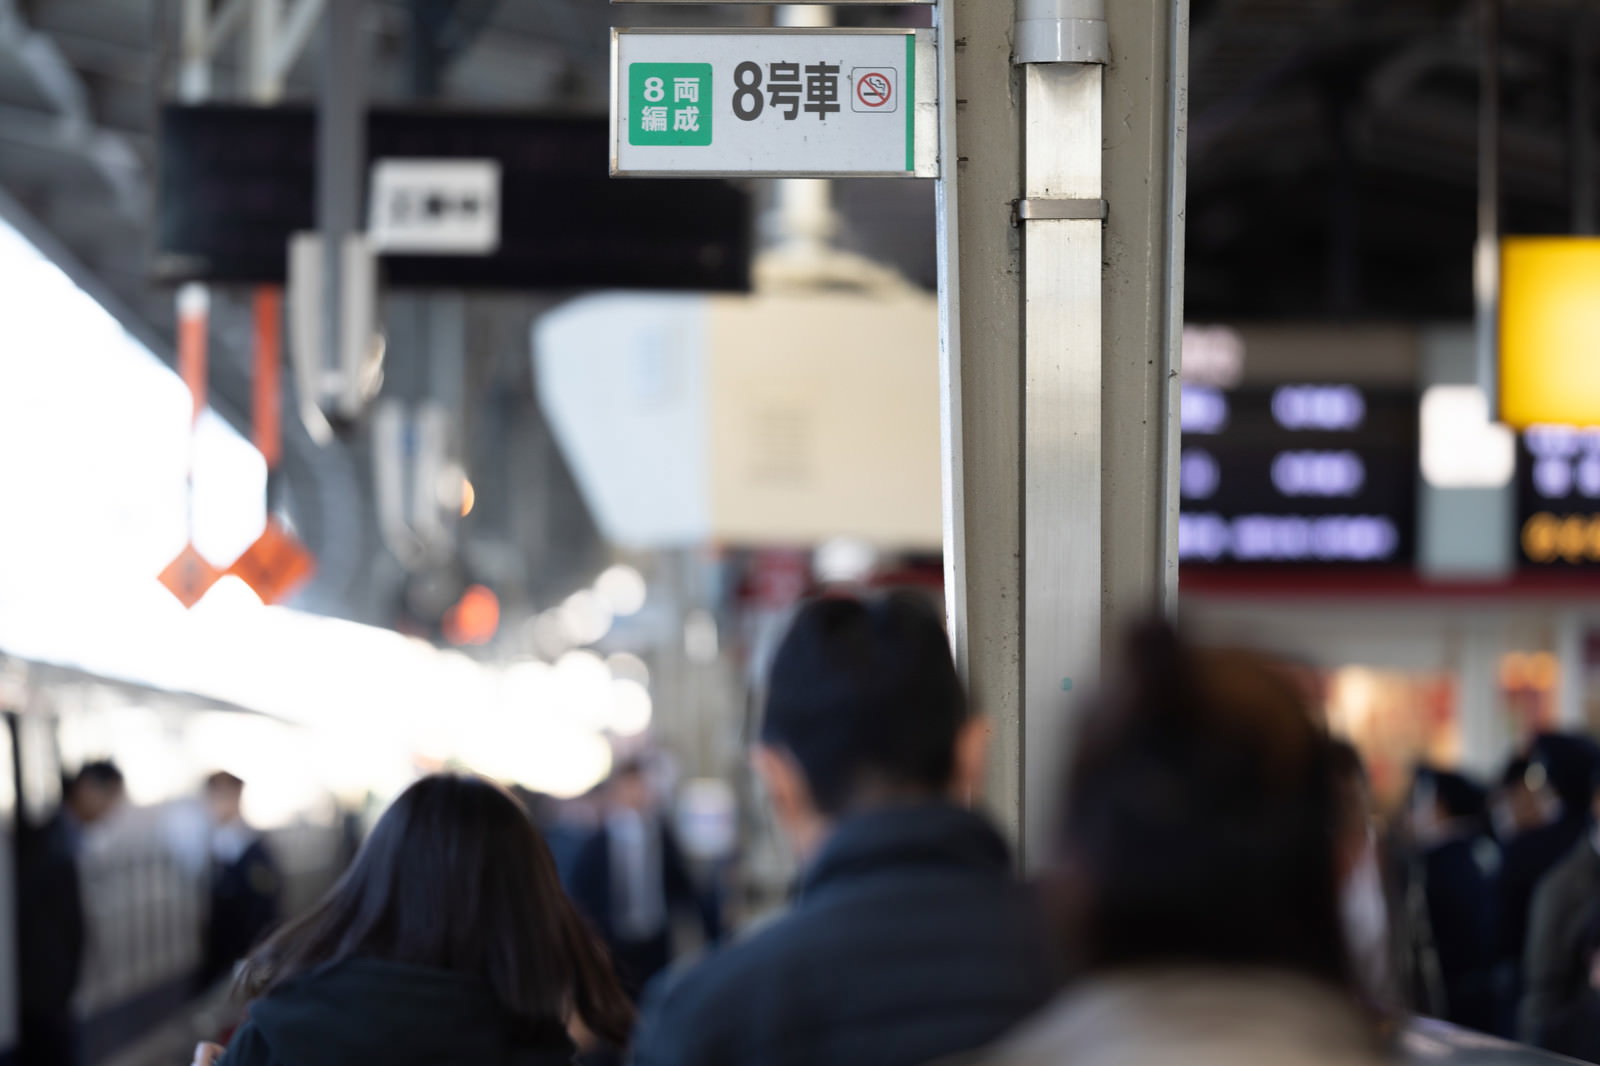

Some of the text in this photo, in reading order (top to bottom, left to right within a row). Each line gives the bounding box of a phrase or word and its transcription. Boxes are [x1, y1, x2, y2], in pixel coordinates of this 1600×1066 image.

[643, 77, 700, 103] 8両
[731, 61, 841, 121] 8号車
[641, 105, 700, 132] 編成
